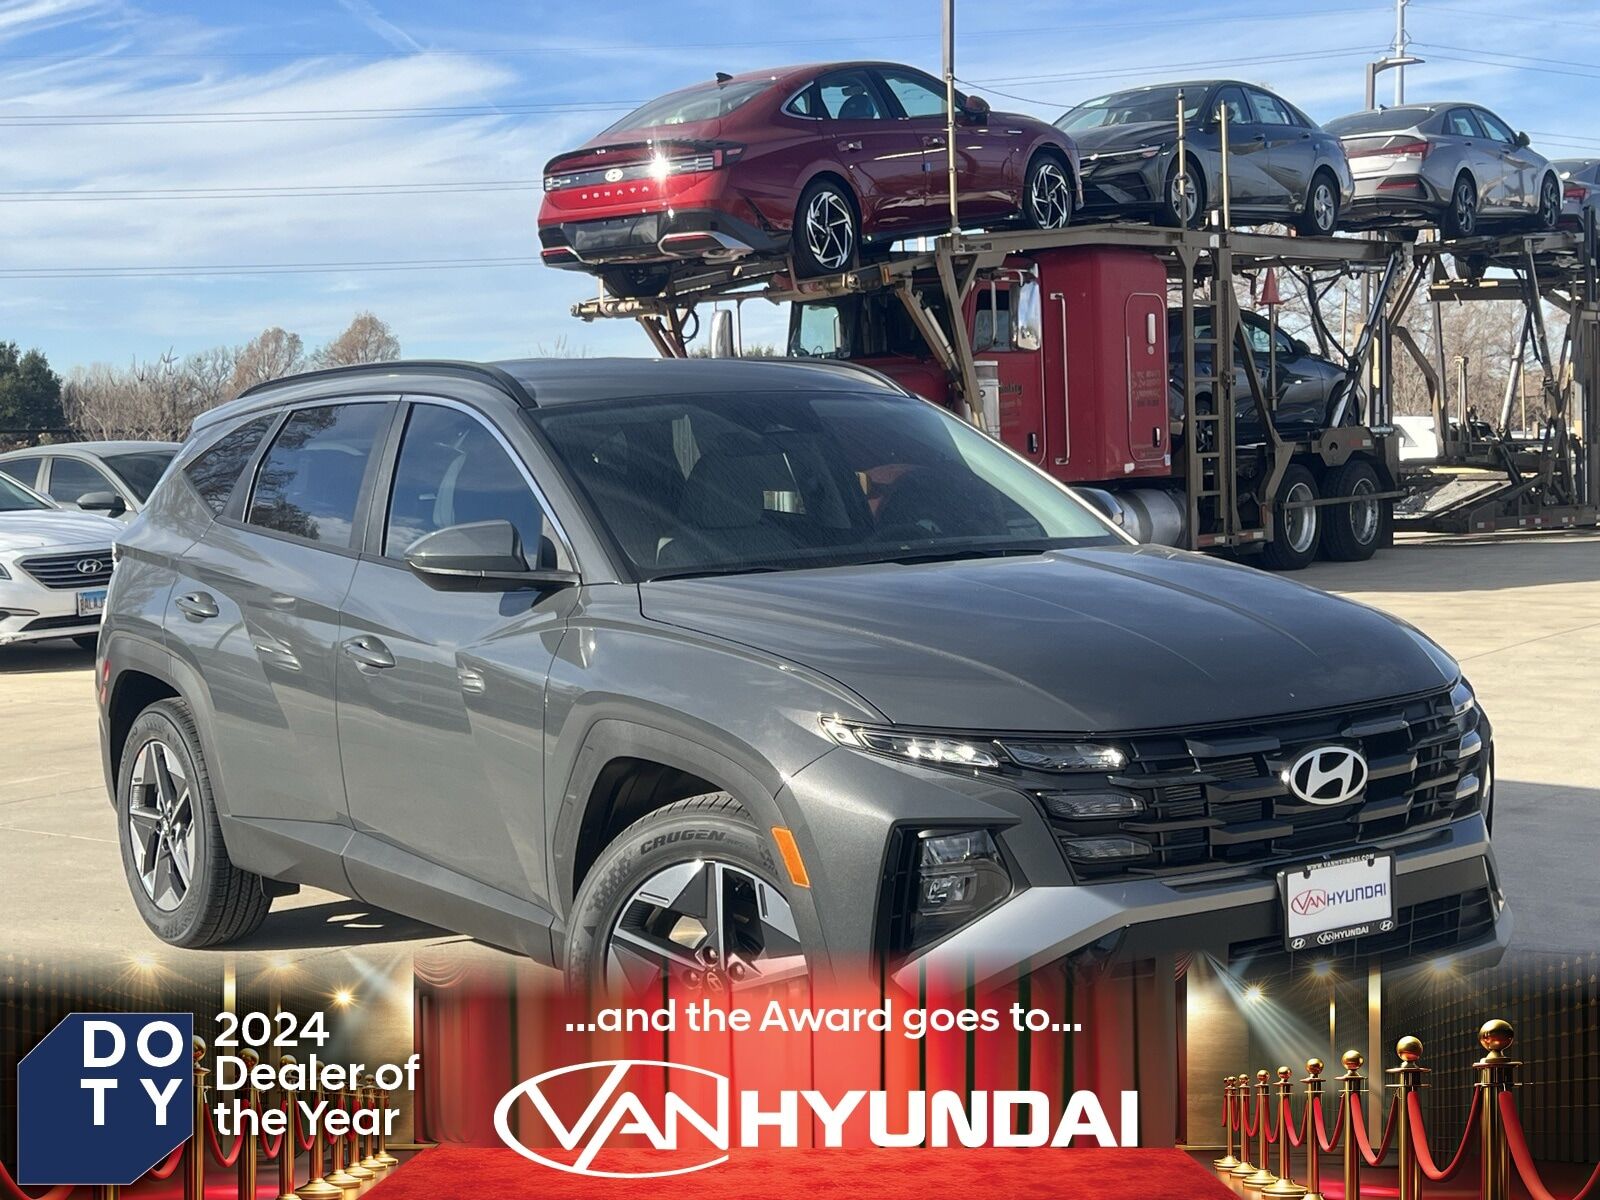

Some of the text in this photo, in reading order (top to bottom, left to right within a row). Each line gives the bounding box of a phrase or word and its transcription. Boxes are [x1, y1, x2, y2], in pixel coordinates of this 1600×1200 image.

[581, 186, 649, 200] SONATA
[640, 829, 726, 856] CRUGEN
[1327, 882, 1387, 907] HYUNDAI
[1334, 926, 1369, 941] HYUNDAI
